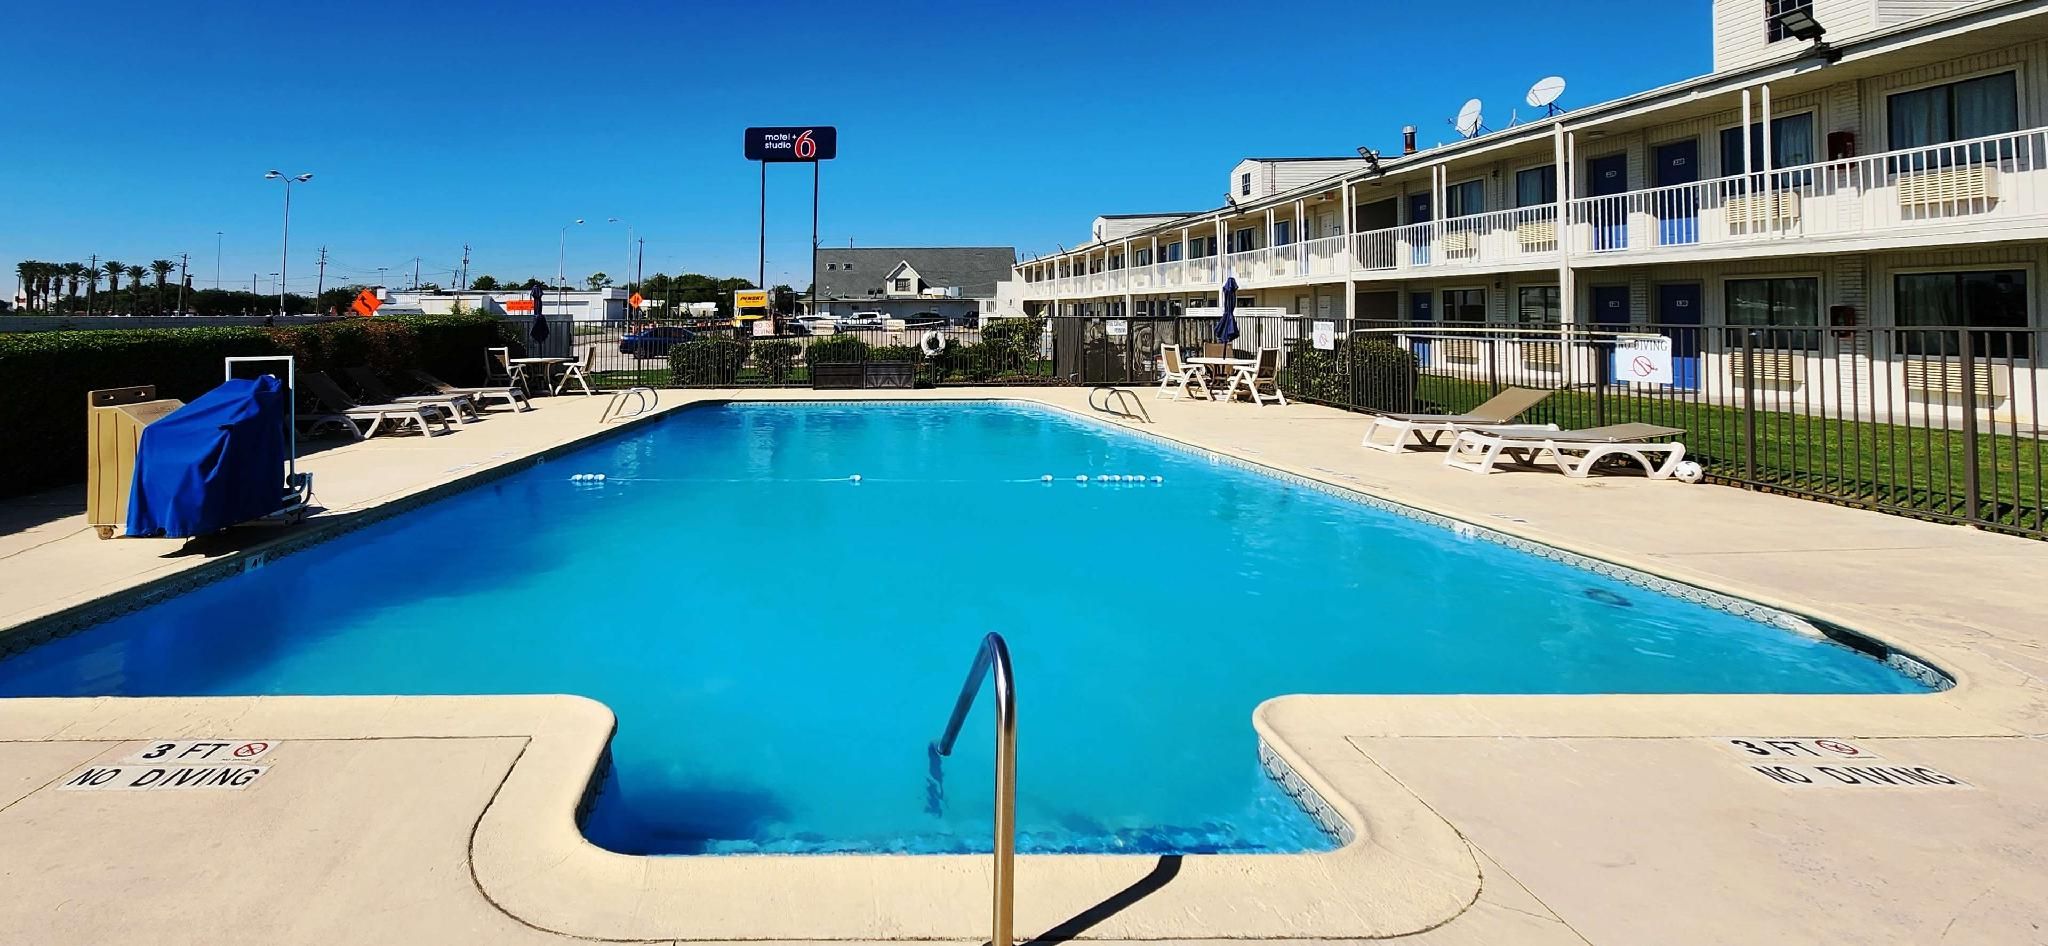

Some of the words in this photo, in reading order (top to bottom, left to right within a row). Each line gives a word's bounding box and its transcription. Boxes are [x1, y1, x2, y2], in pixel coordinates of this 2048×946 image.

[765, 133, 790, 141] motel
[765, 141, 791, 149] studio
[794, 129, 816, 158] 6
[1634, 339, 1668, 351] DIVING
[142, 743, 176, 759] 3
[176, 743, 231, 759] FT
[1731, 740, 1771, 756] 3
[1763, 740, 1821, 757] FT
[66, 768, 122, 786] NO
[128, 768, 260, 787] DIVING
[1750, 766, 1813, 784] NO
[1814, 766, 1961, 785] DIVING
